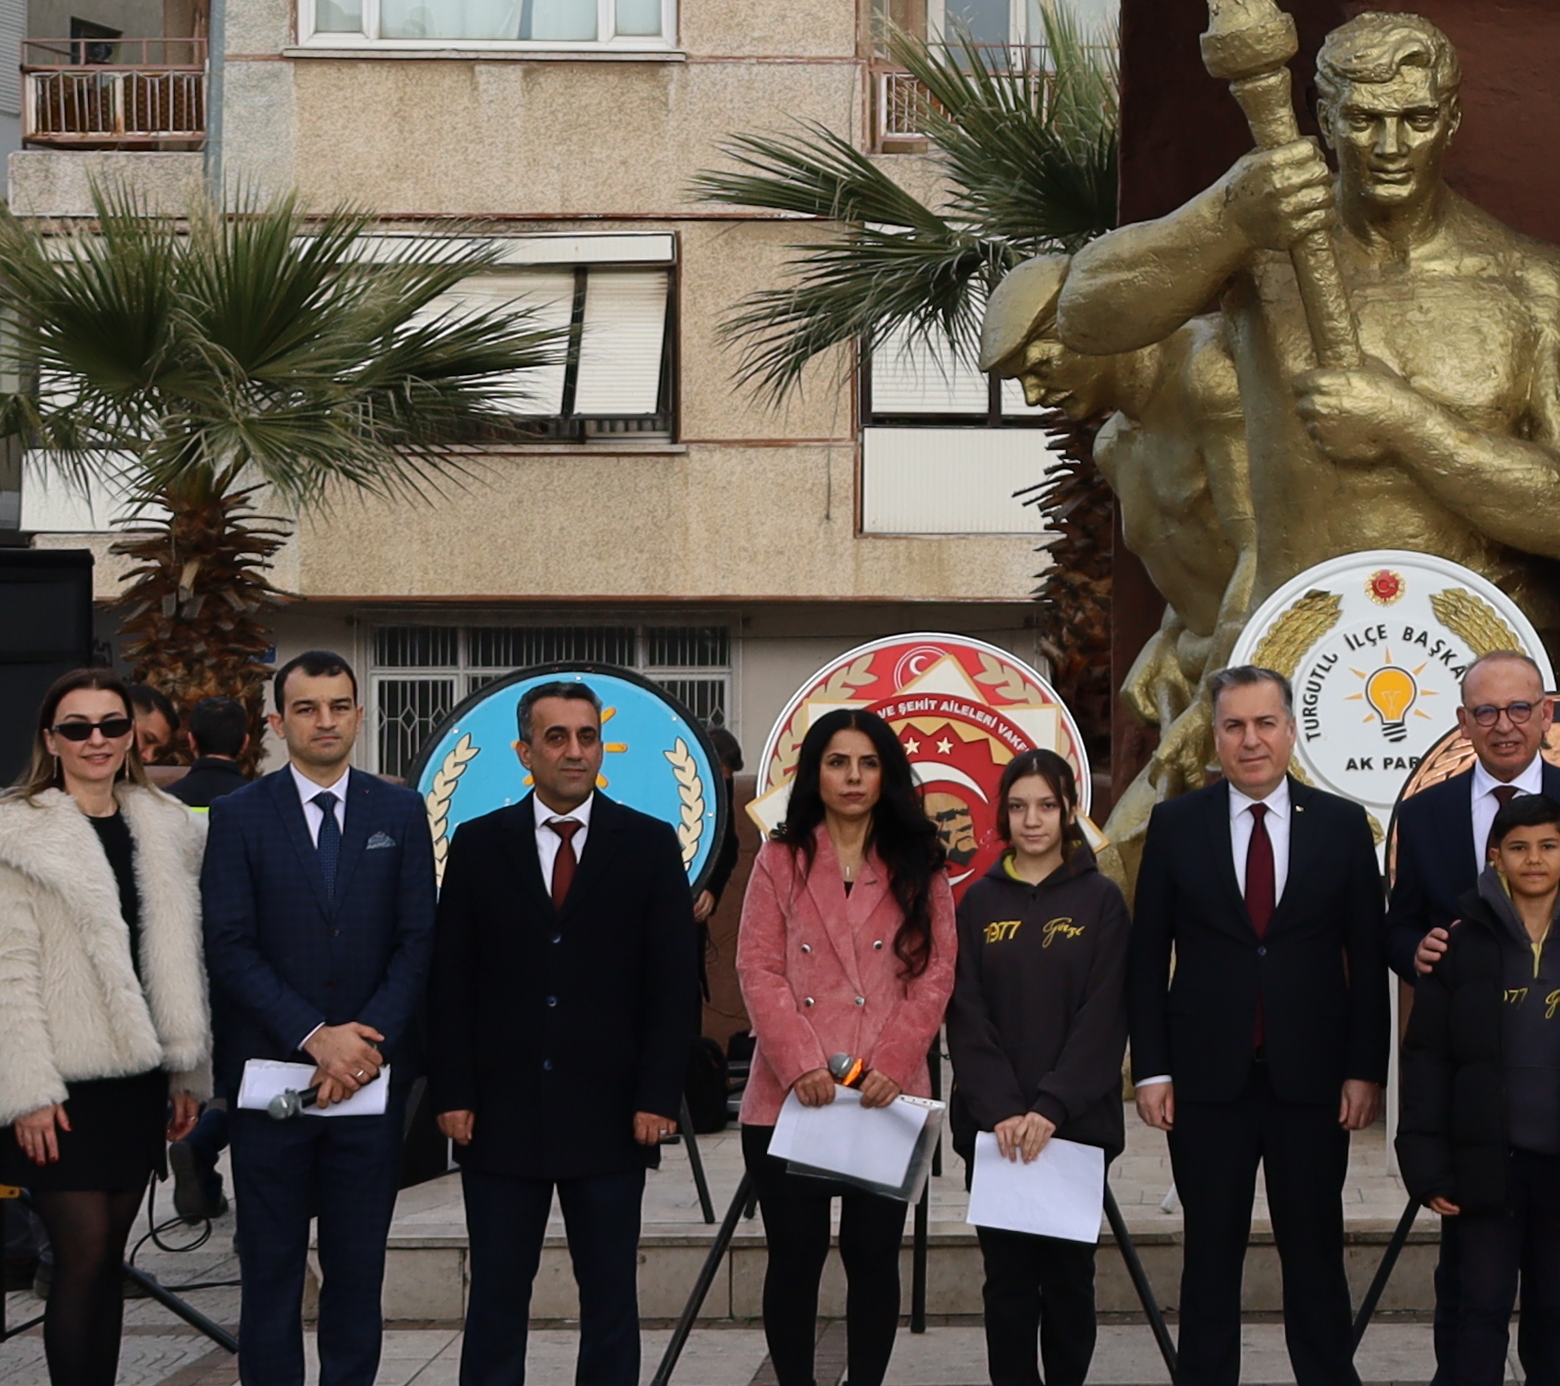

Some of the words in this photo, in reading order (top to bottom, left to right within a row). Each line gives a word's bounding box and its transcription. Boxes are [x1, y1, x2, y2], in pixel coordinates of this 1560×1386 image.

[1343, 624, 1388, 651] İLÇE
[1402, 626, 1469, 686] BAŞKA
[897, 697, 938, 716] ŞEHİT
[1345, 757, 1374, 772] AK
